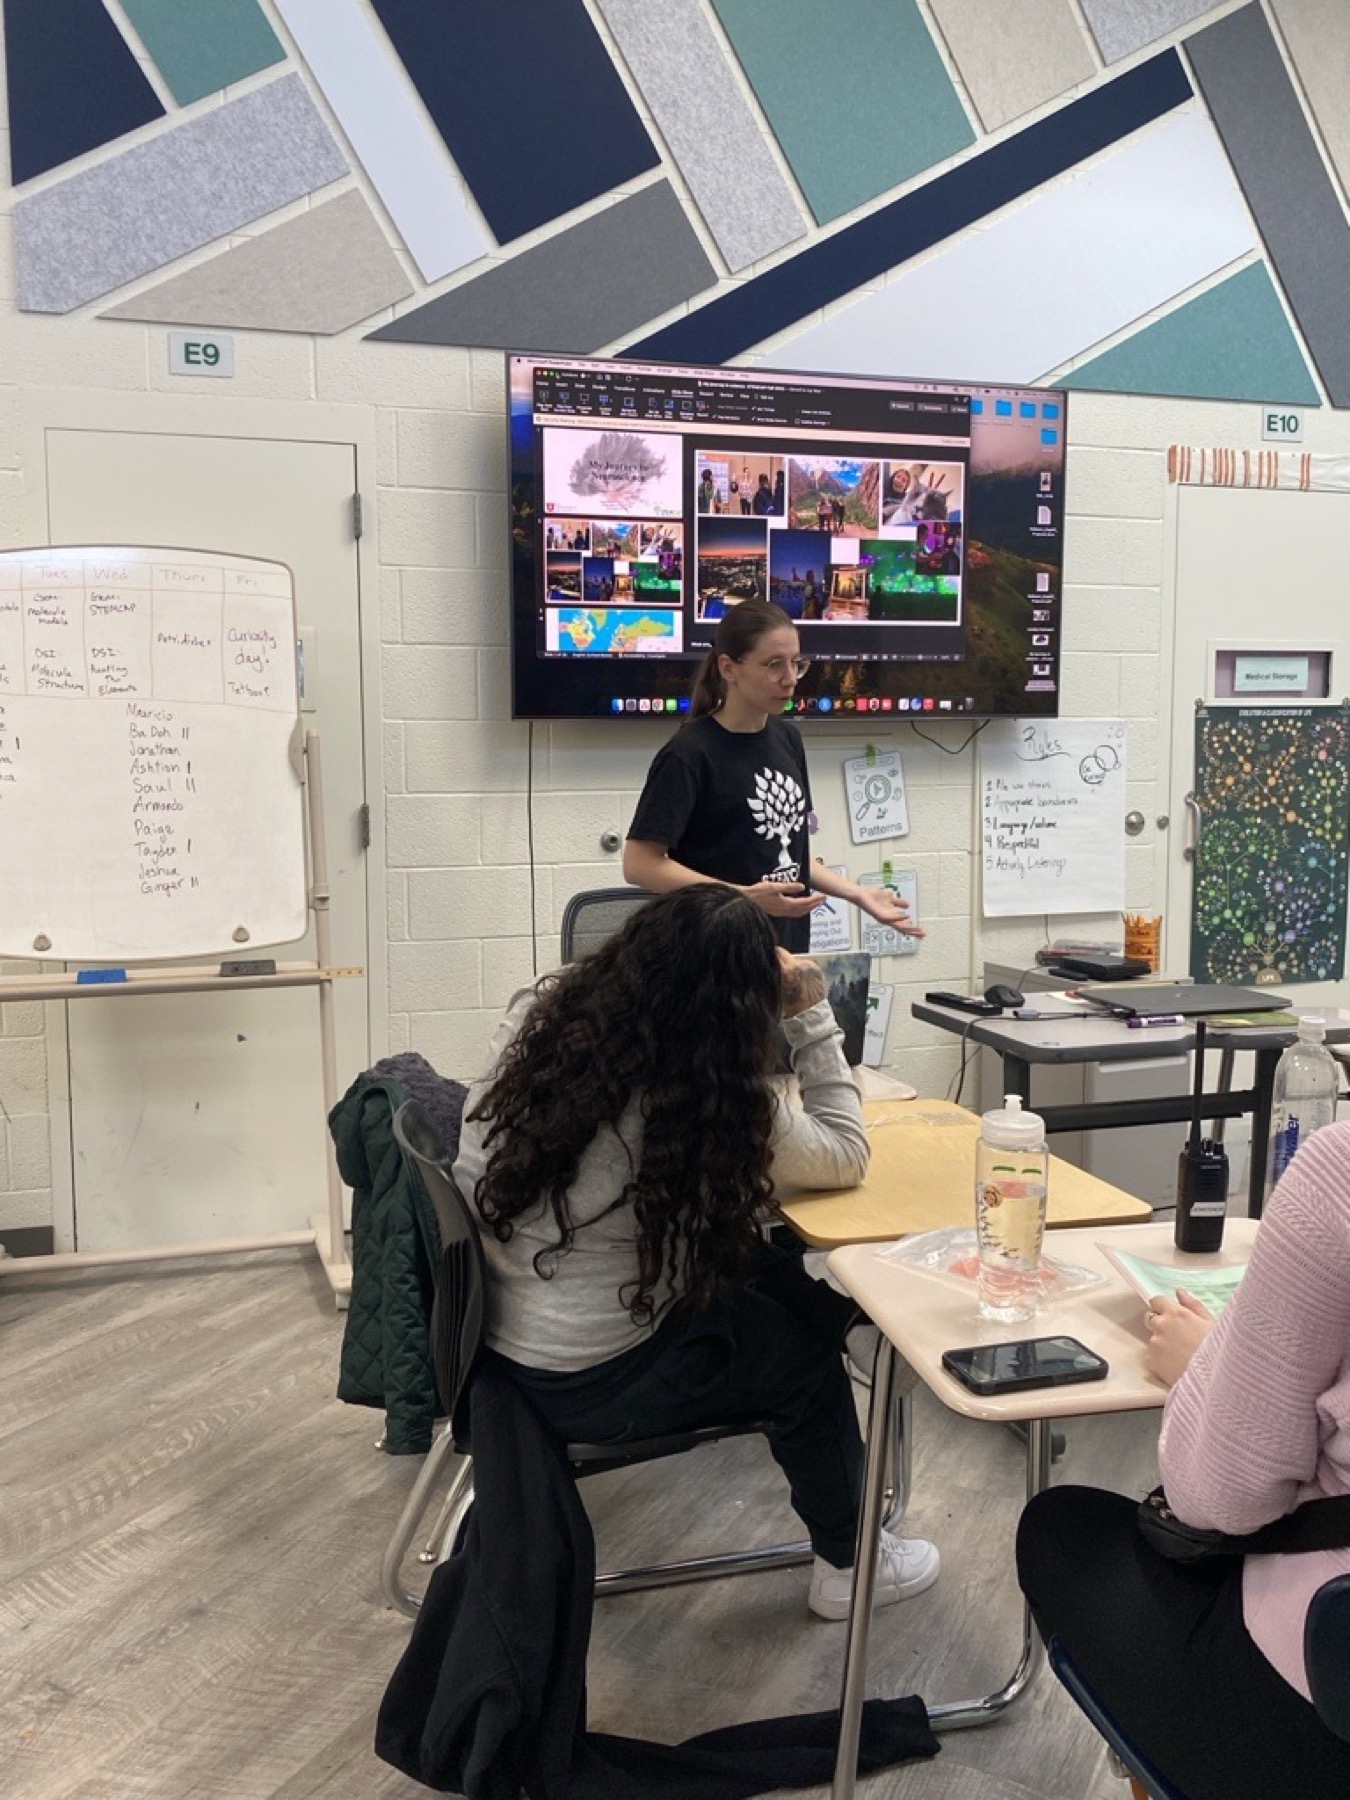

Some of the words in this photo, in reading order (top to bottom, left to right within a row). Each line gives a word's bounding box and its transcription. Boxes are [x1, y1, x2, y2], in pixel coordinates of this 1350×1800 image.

[184, 342, 220, 366] E9
[1266, 414, 1300, 433] E10
[93, 567, 128, 581] Wed
[1245, 672, 1271, 681] Medical
[1272, 672, 1298, 681] Storage
[129, 739, 182, 757] Jonathan
[132, 776, 173, 794] Saul
[132, 795, 184, 813] Armando
[134, 818, 175, 845] Paige
[859, 823, 903, 838] Patterns
